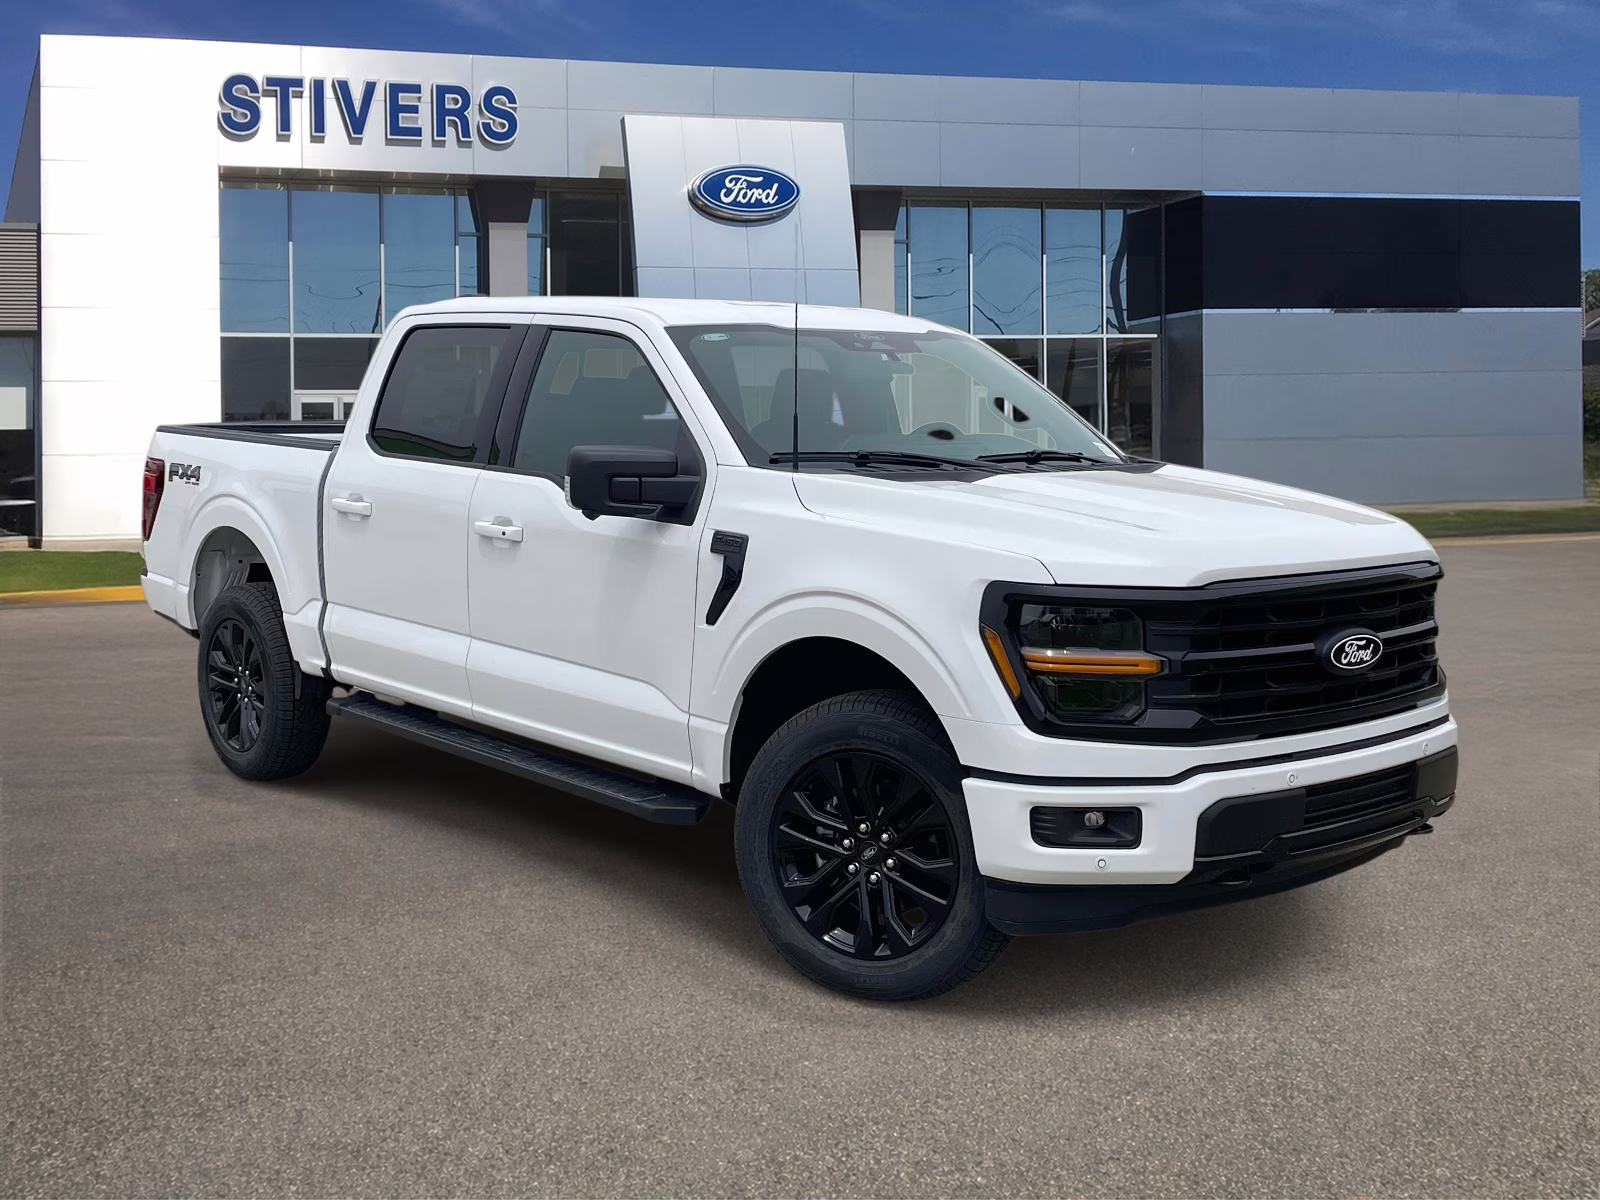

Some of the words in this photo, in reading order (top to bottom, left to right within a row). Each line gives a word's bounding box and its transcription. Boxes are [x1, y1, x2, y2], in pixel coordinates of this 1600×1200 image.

[219, 73, 519, 143] STIVERS
[720, 174, 779, 205] Ford
[168, 462, 201, 482] FX4
[1341, 639, 1374, 664] Ford
